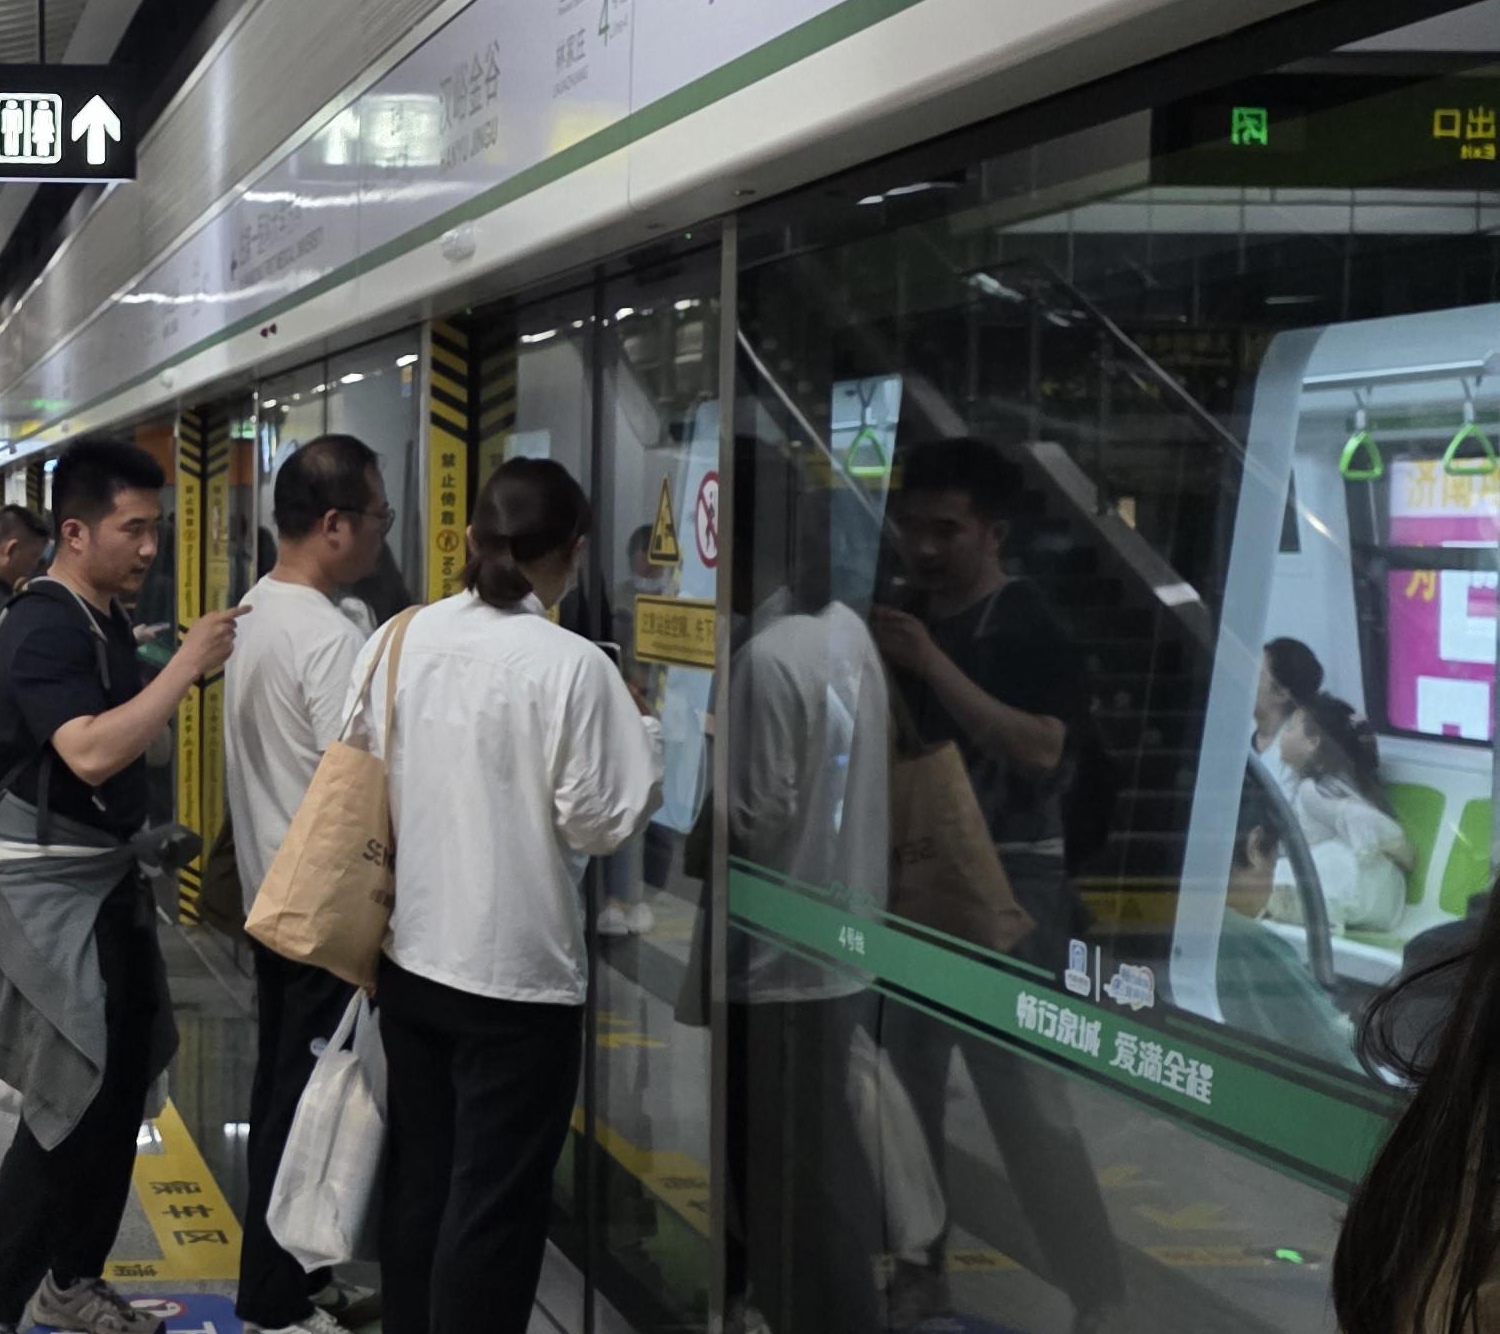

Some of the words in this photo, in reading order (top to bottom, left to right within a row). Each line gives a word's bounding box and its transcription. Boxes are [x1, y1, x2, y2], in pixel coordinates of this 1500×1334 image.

[1016, 990, 1102, 1058] 畅行泉城
[1109, 1030, 1214, 1105] 爱满全程
